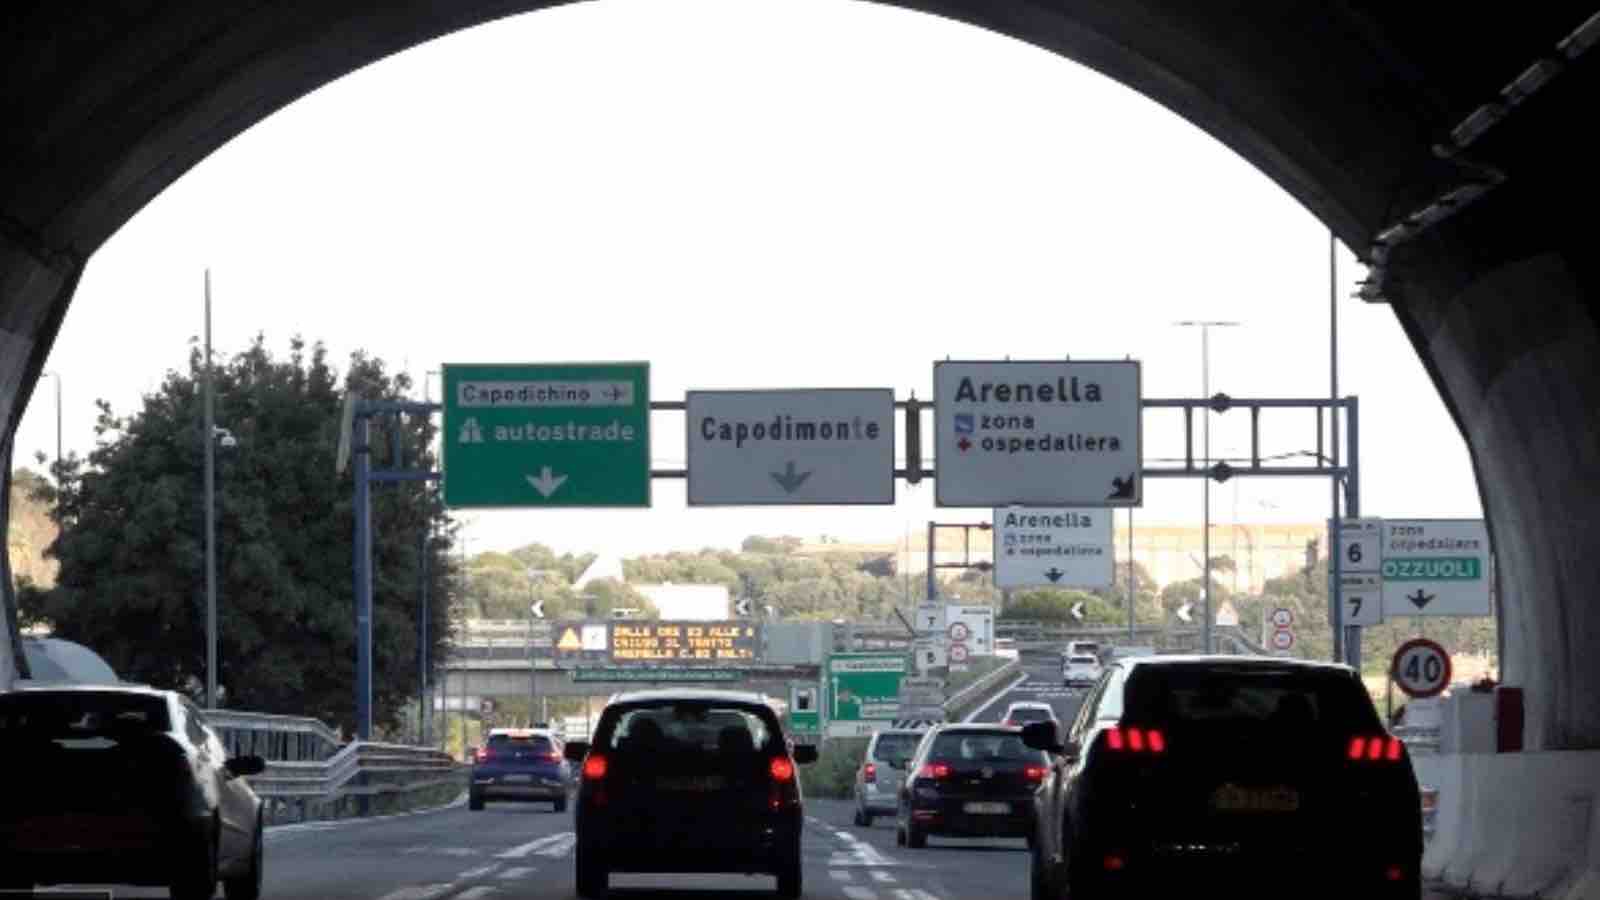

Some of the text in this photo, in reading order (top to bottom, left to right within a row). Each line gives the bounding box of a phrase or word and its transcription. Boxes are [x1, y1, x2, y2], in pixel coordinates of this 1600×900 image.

[462, 384, 591, 404] Capodichino
[954, 376, 1103, 403] Arenella
[494, 419, 635, 441] autostrade
[701, 416, 880, 448] Capodimonte
[980, 414, 1035, 430] zona
[980, 434, 1121, 454] ospedaliera
[1004, 512, 1093, 528] Arenella
[1347, 542, 1362, 563] 6
[1348, 597, 1362, 618] 7
[1404, 655, 1441, 683] 40
